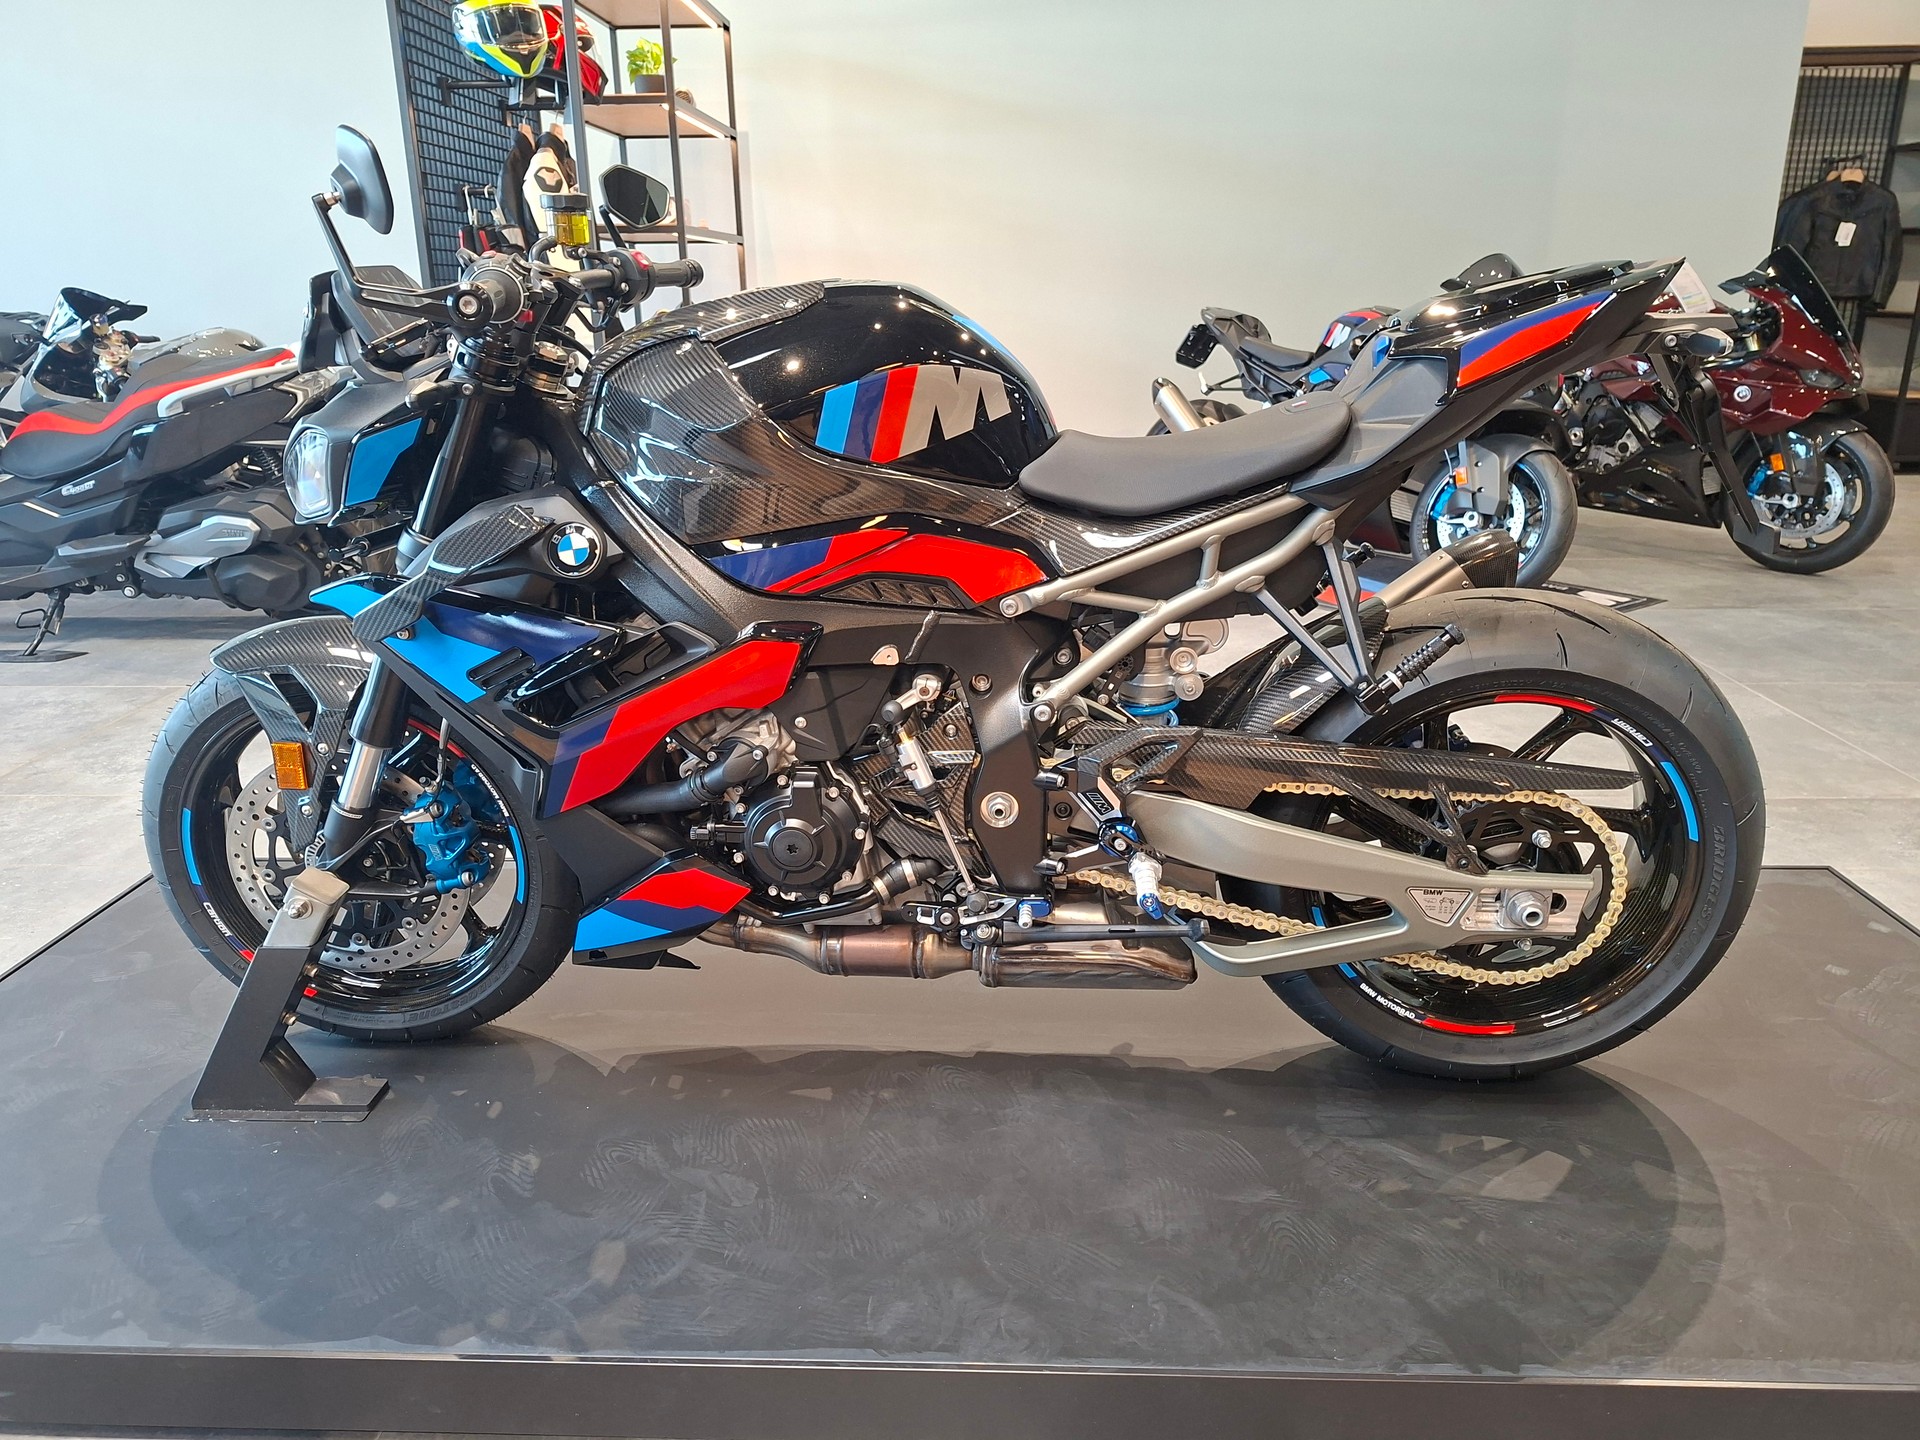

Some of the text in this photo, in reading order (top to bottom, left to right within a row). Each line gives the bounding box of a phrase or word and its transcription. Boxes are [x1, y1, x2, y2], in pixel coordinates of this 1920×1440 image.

[898, 364, 1012, 459] M
[1610, 718, 1654, 748] carbon
[1422, 888, 1444, 896] BMW
[1671, 824, 1730, 971] BRIDGESTONE
[202, 901, 234, 938] carbon
[1359, 982, 1417, 1020] BMW MOTORRAD
